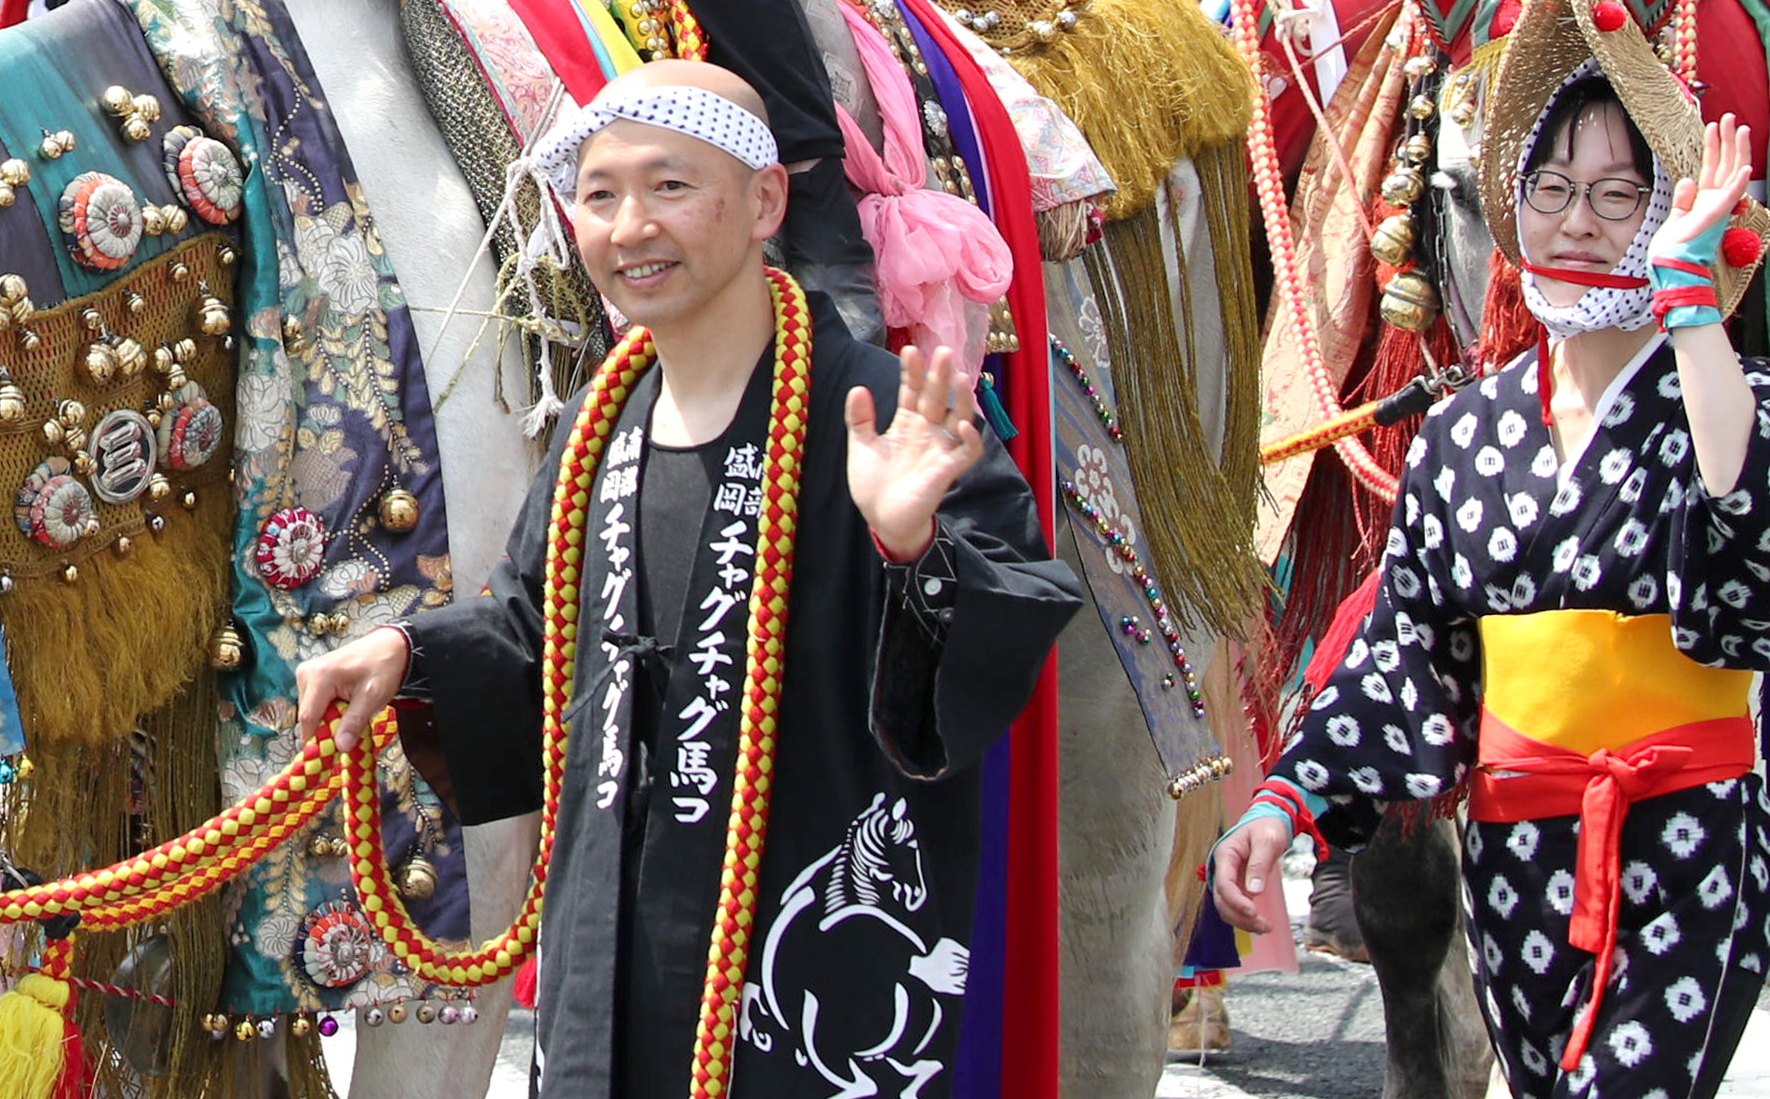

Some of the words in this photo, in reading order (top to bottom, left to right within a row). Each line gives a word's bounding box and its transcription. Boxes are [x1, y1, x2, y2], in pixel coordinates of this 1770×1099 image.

[600, 431, 630, 504] 盛岡
[713, 443, 757, 516] 盛岡
[669, 519, 755, 824] チャグチャグ馬コ
